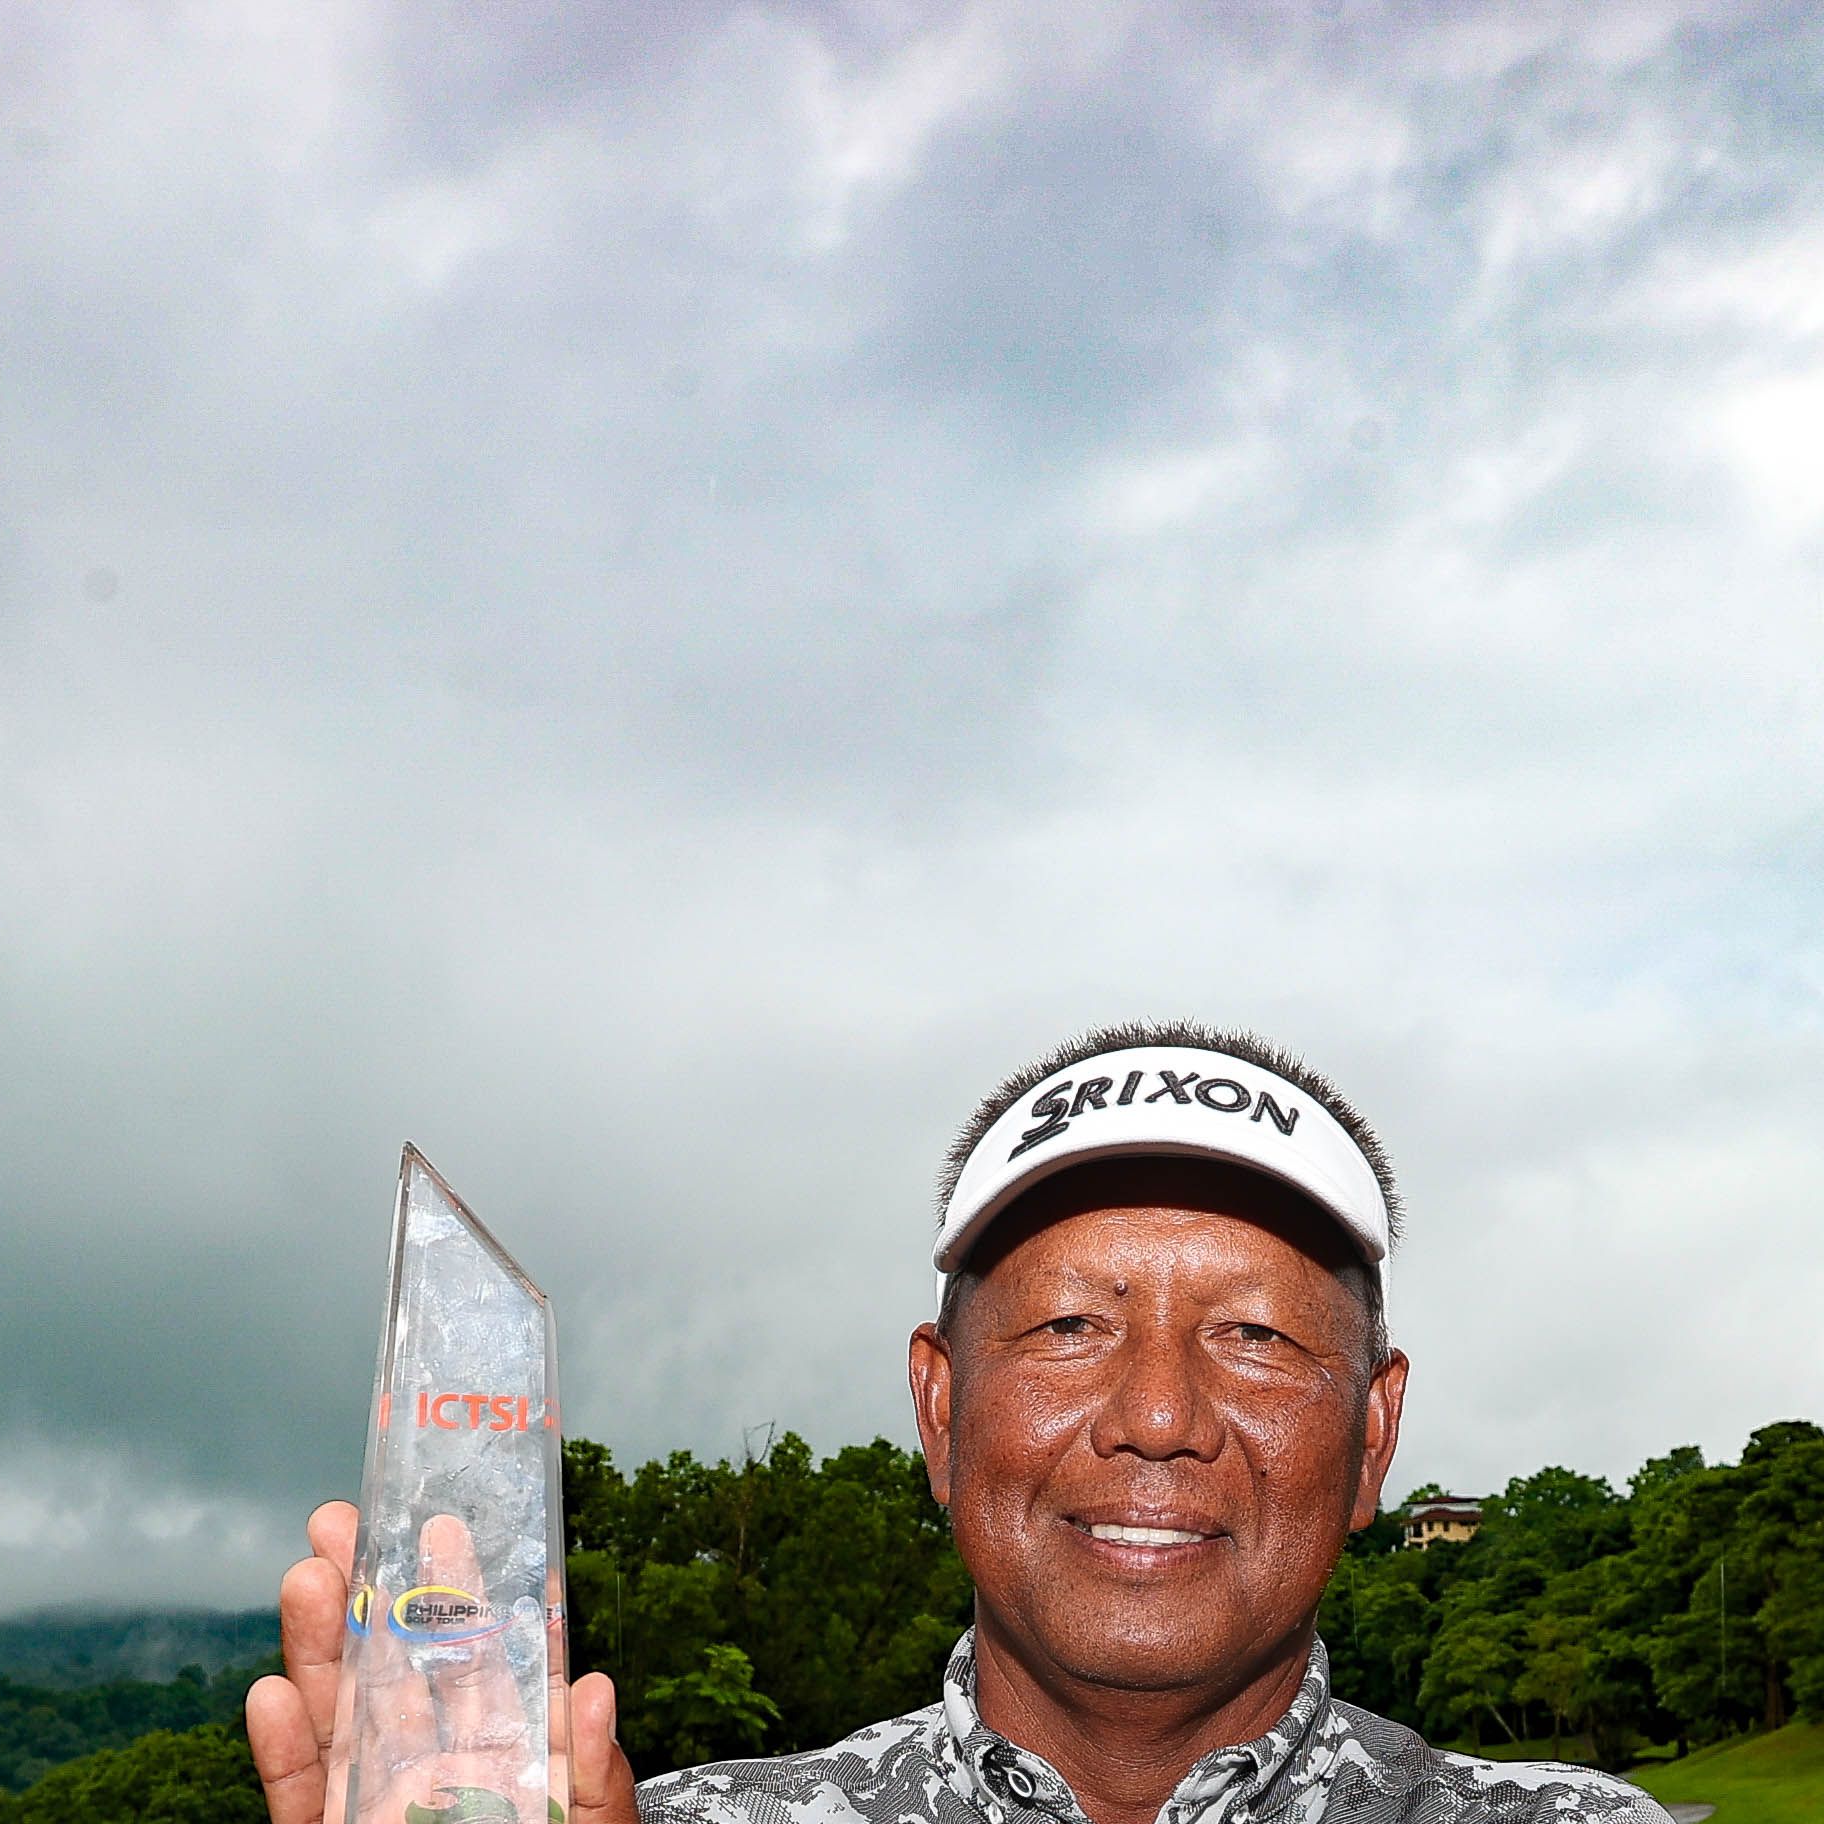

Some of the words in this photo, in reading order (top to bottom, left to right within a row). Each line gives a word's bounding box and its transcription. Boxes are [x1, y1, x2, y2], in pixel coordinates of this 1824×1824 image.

[1007, 1069, 1300, 1163] SRIXON
[416, 1391, 529, 1432] ICTSI
[437, 1616, 466, 1625] TOUR
